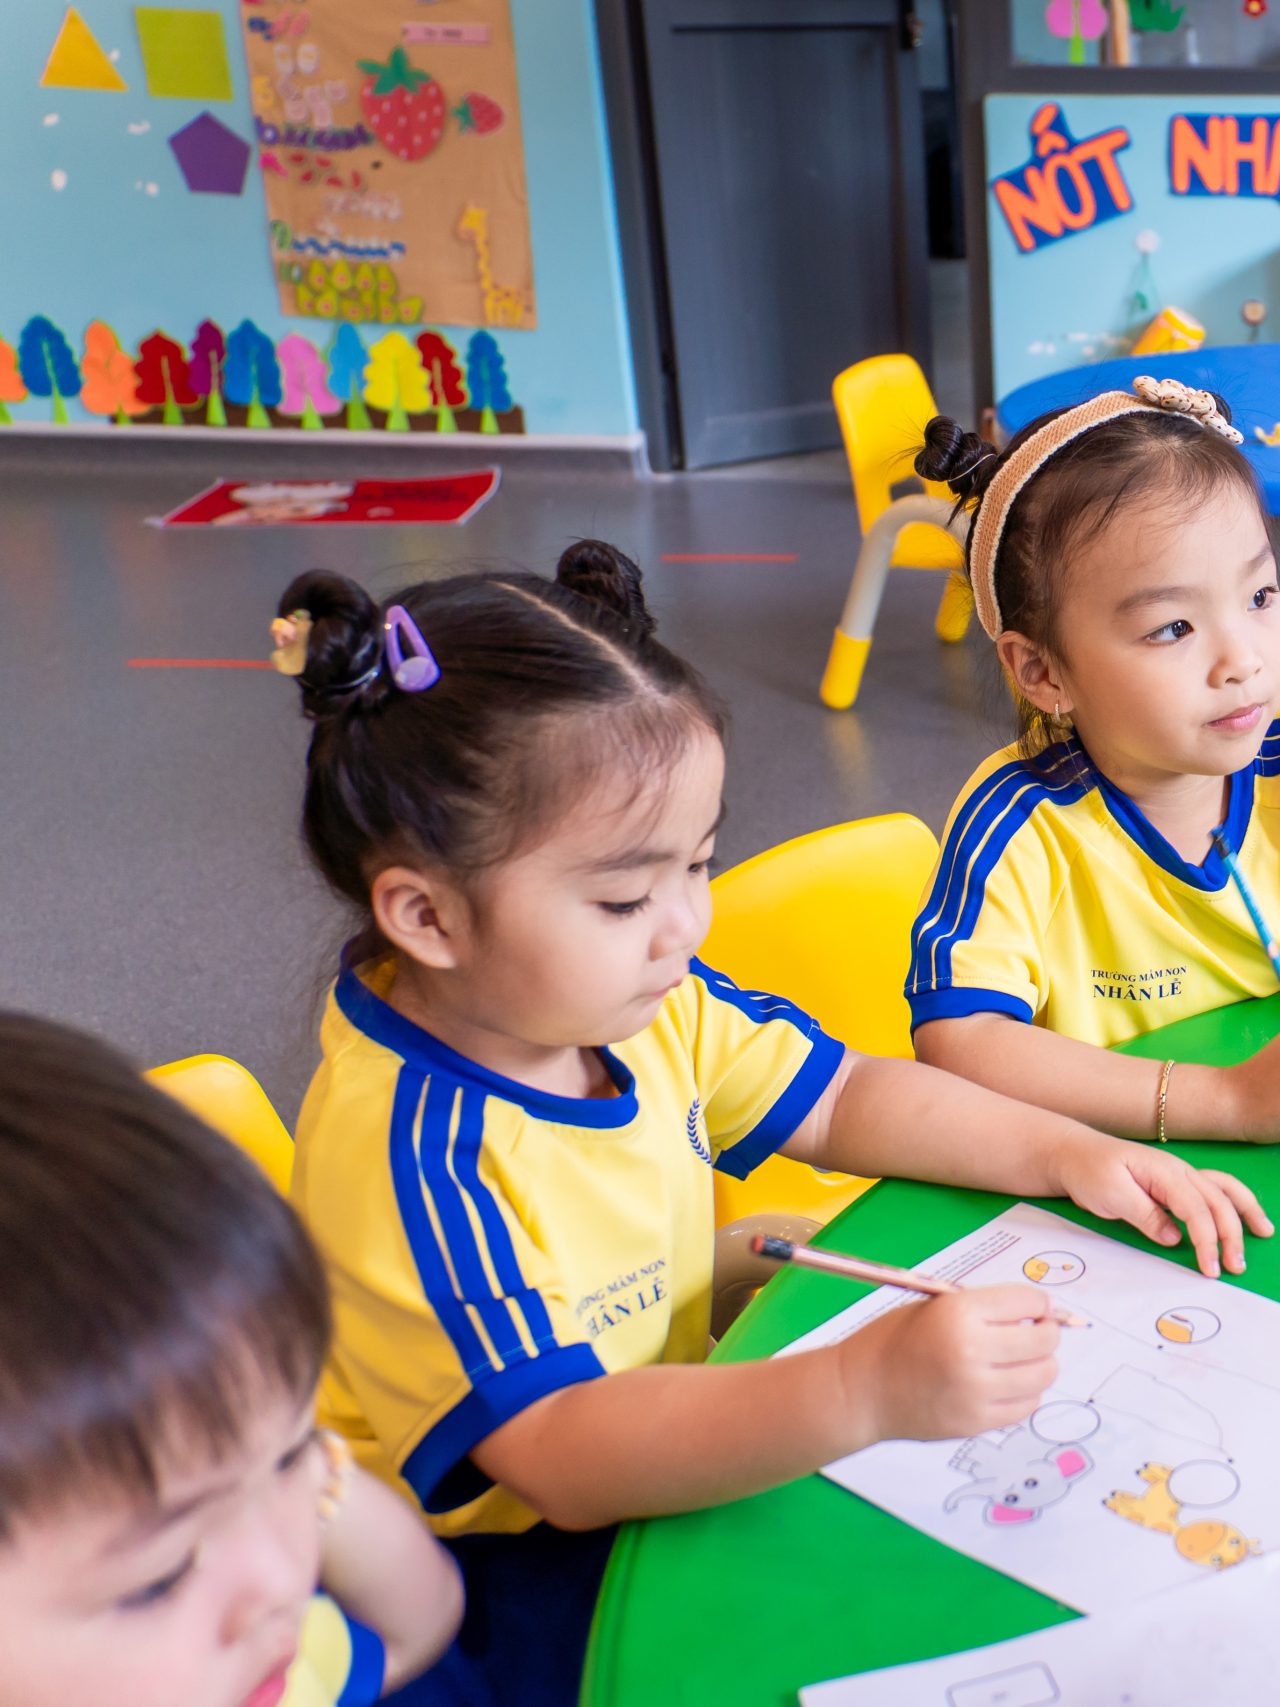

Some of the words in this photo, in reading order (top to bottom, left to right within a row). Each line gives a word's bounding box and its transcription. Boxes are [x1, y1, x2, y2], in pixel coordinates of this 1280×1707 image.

[994, 103, 1133, 252] NỐT
[1165, 965, 1187, 977] NON
[1093, 984, 1152, 1001] NHÂN
